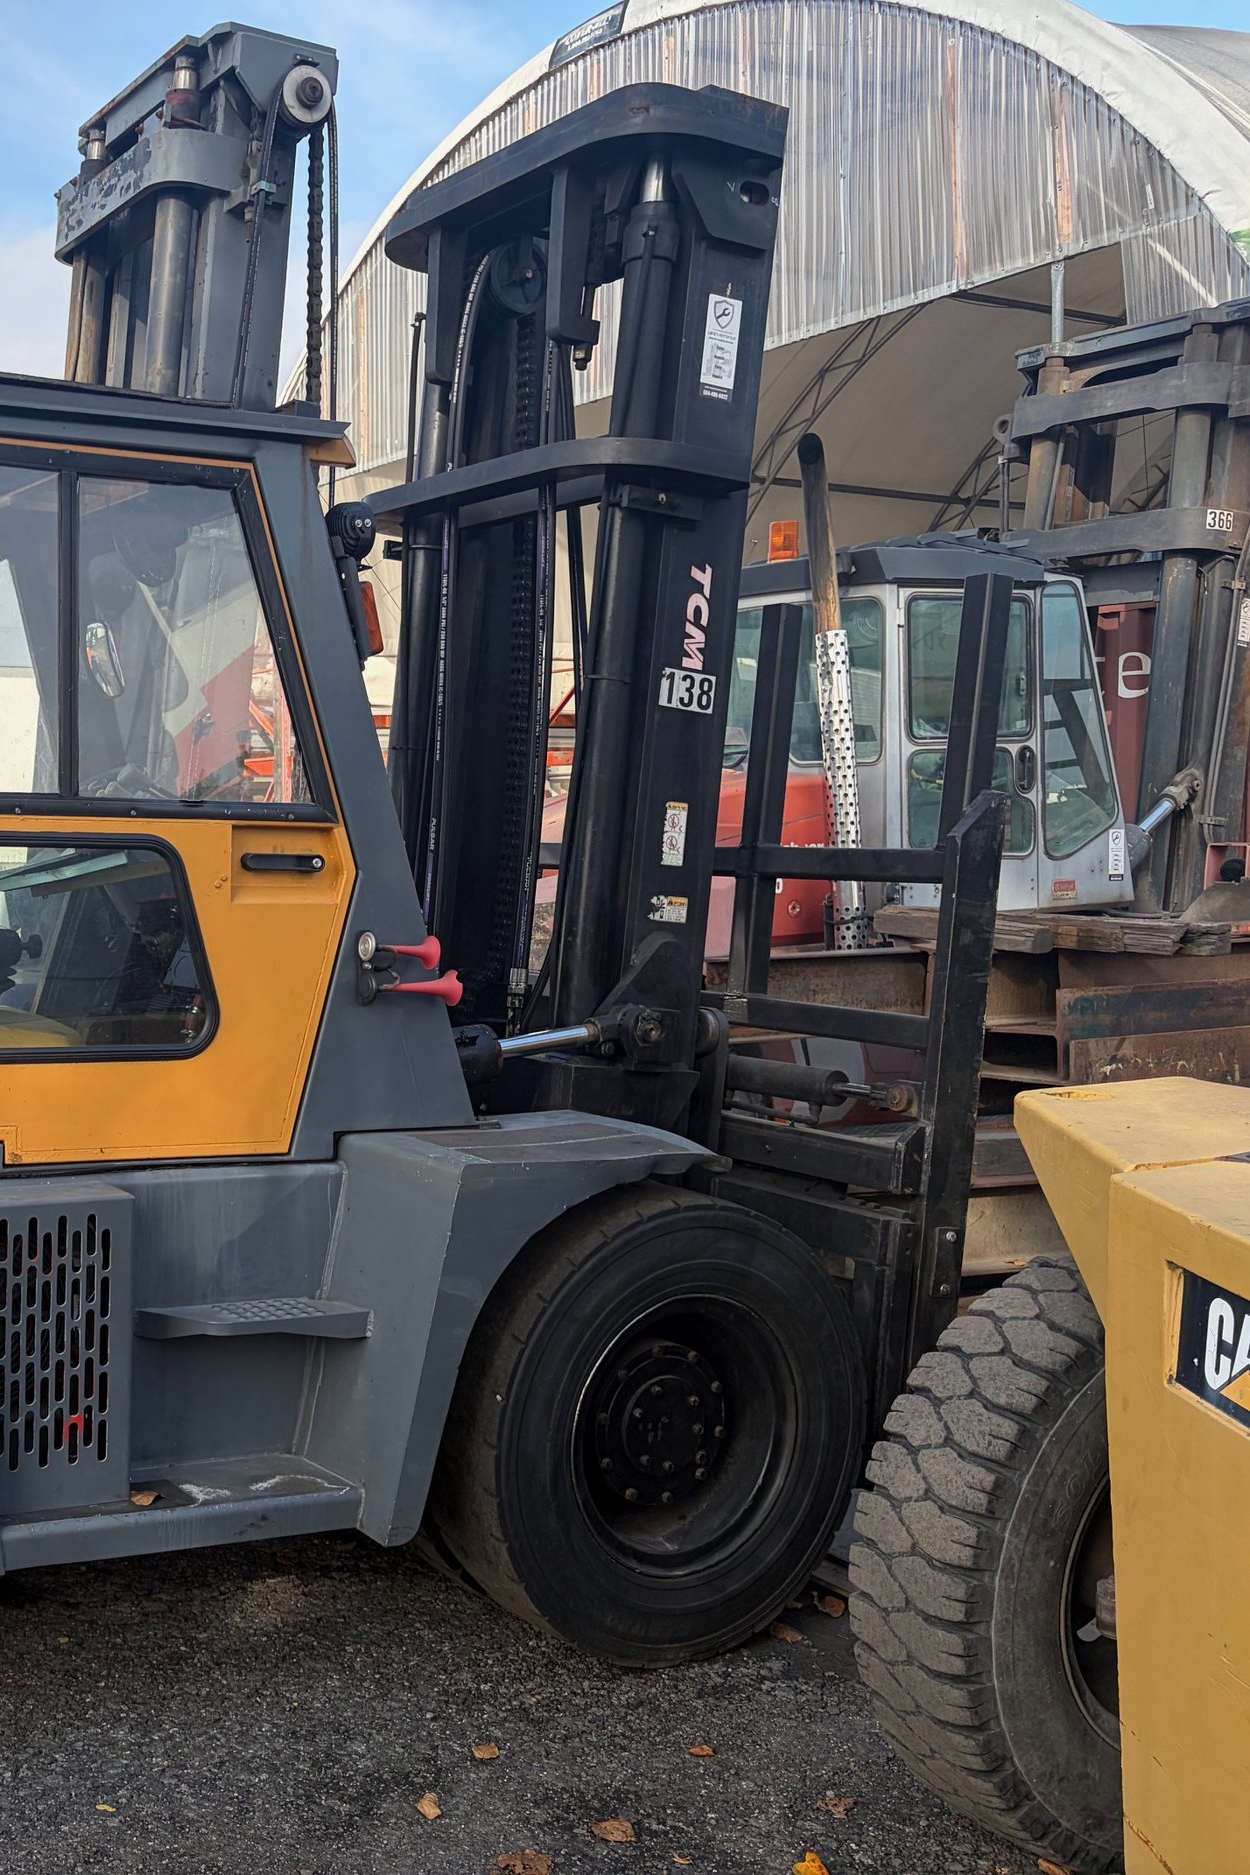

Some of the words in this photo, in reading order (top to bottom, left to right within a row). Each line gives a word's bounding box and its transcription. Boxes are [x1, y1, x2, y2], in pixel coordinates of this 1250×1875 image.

[1208, 511, 1232, 530] 366
[681, 563, 713, 671] TCM
[664, 671, 714, 711] 138
[1102, 651, 1152, 699] e
